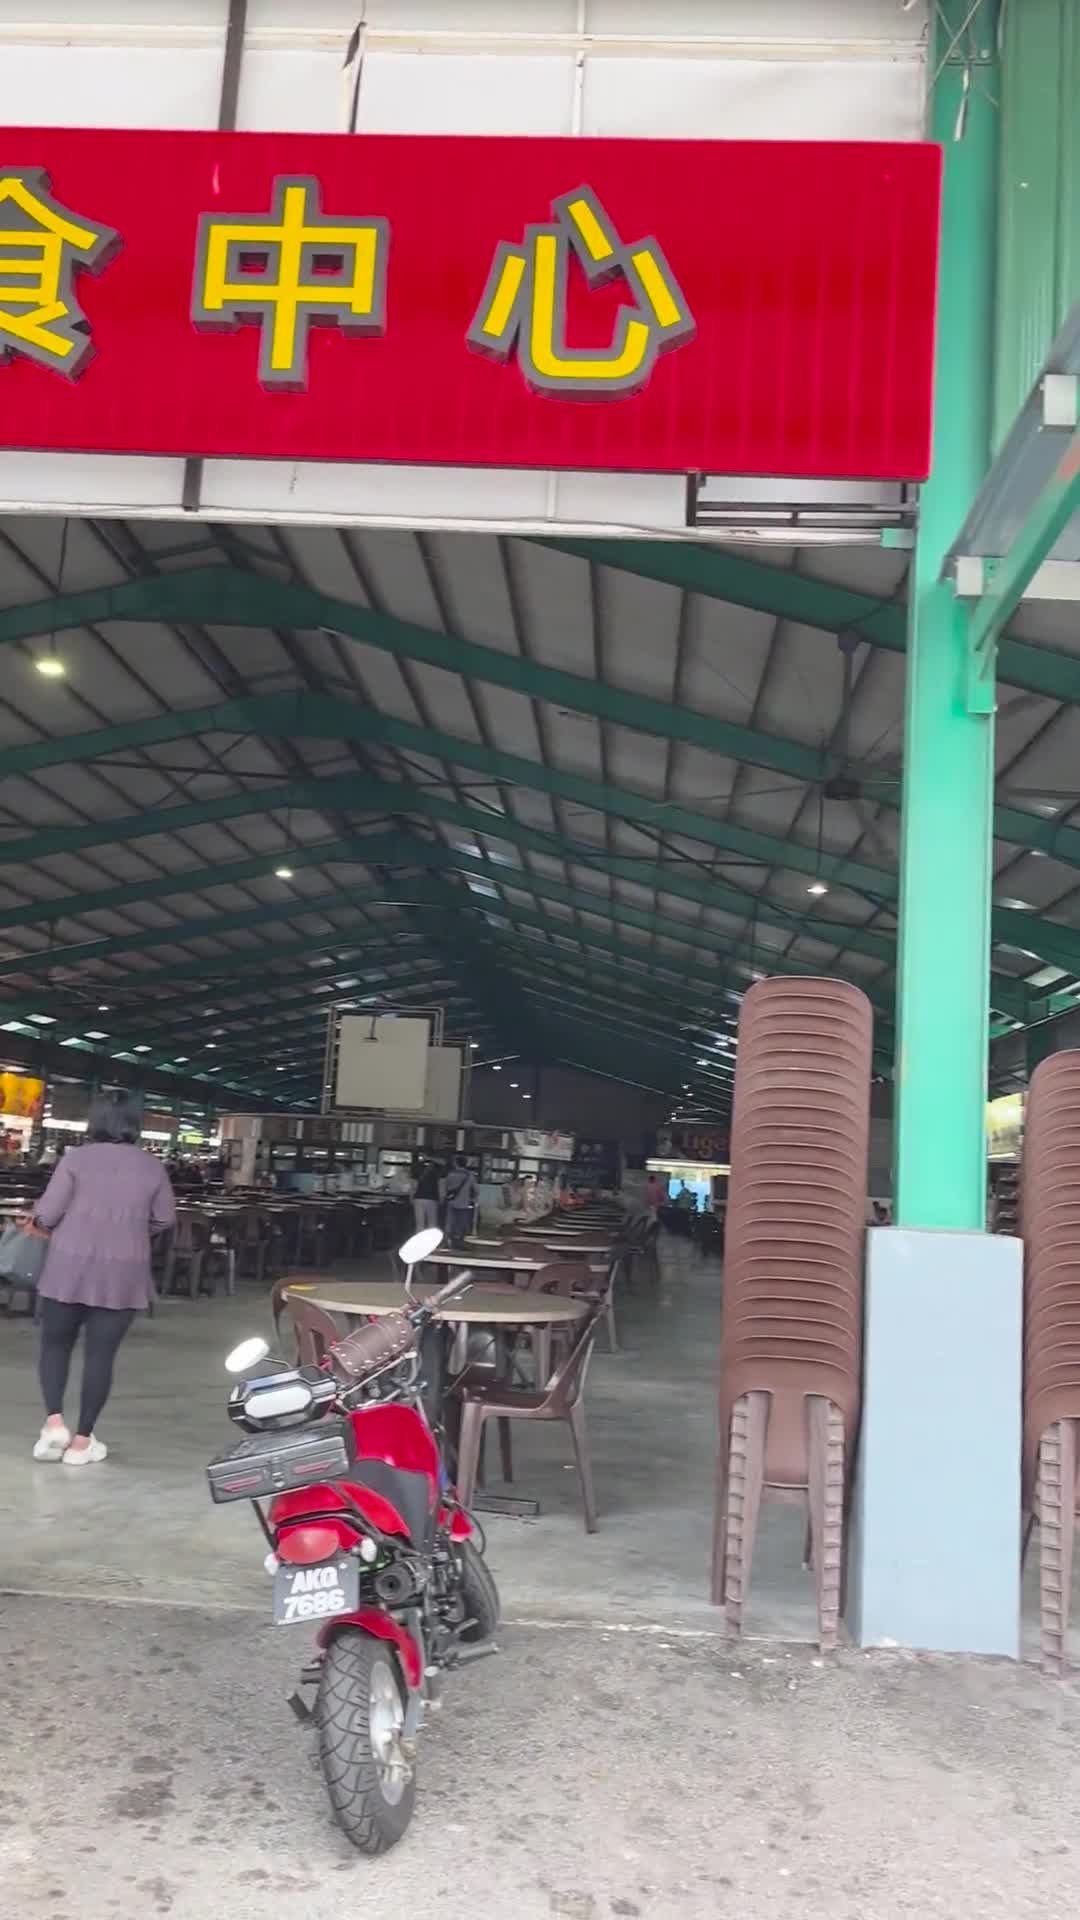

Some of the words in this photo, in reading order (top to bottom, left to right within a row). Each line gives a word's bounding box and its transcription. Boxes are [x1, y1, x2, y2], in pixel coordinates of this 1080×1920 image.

[0, 168, 692, 388] 食中心
[284, 1588, 345, 1619] 7686
